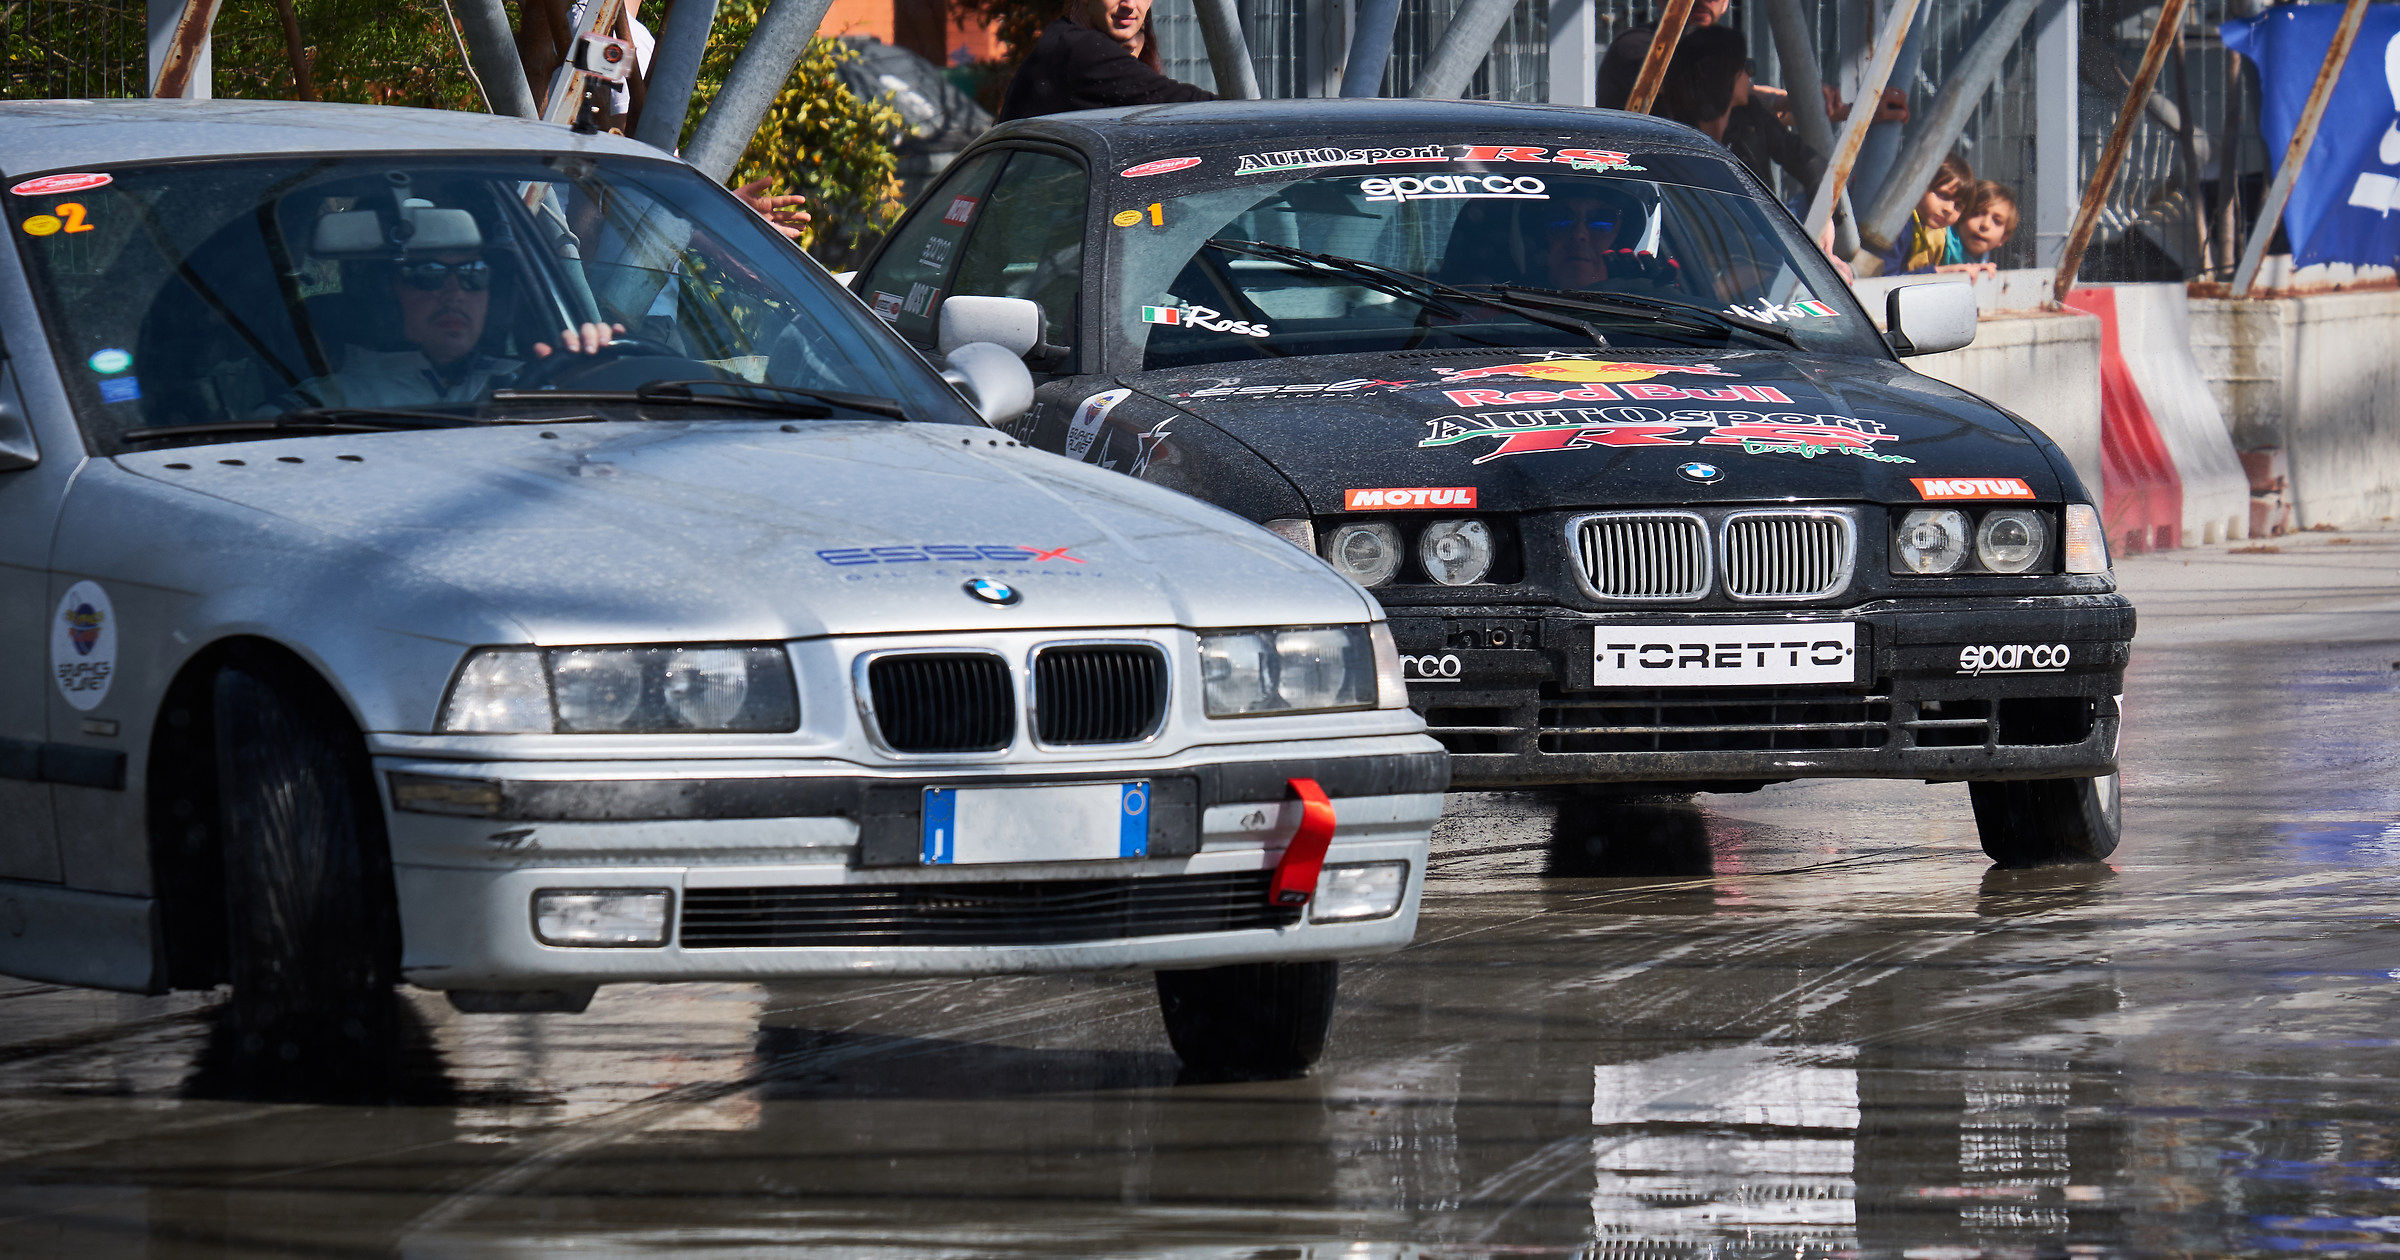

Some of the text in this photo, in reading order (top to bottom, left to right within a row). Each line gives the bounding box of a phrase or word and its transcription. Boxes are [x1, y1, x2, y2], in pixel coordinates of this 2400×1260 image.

[1453, 145, 1631, 166] RS
[1360, 176, 1548, 203] sparco
[55, 202, 95, 233] 2
[1147, 202, 1164, 226] 1
[1443, 383, 1796, 408] Red Bull
[1741, 441, 1917, 464] Drift Team
[1352, 490, 1472, 507] MOTUL
[1923, 479, 2029, 497] MOTUL
[815, 544, 1088, 567] ESSEX
[1606, 640, 1844, 669] TORETTO
[1957, 643, 2071, 677] sparco
